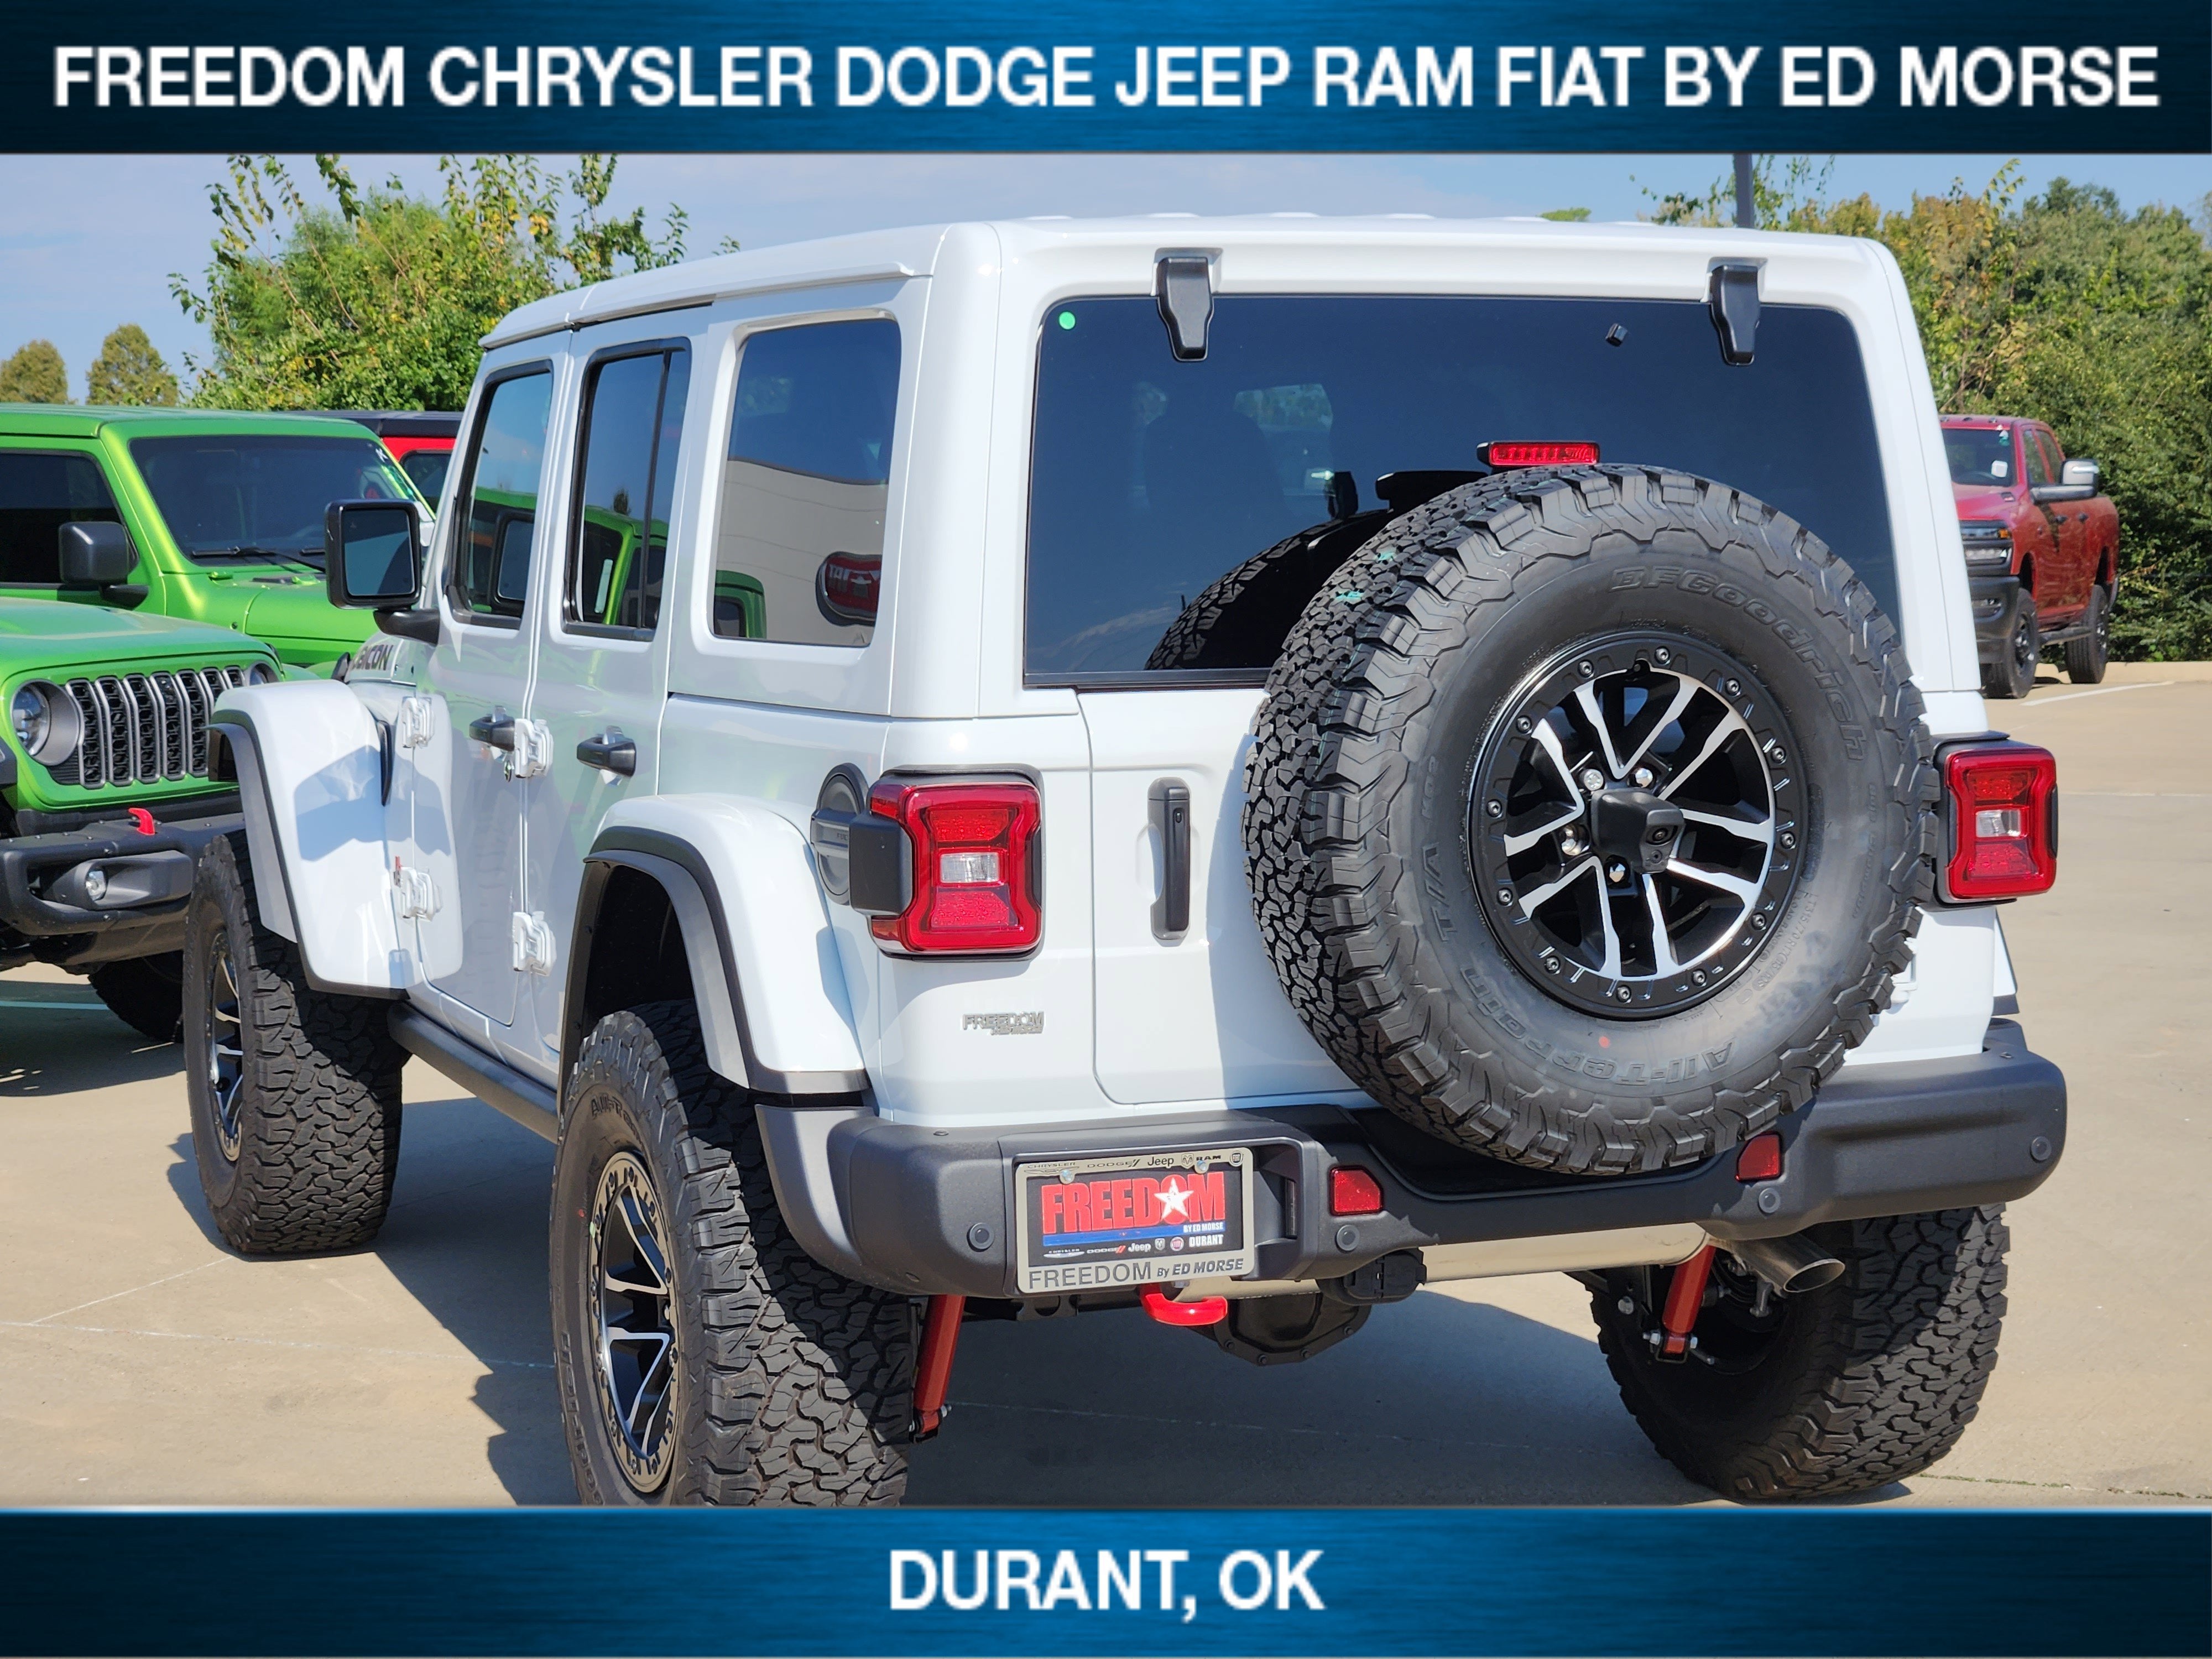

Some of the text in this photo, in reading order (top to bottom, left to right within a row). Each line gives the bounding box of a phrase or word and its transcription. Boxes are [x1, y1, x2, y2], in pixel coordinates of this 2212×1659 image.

[1608, 565, 1867, 761] BFGoodrich
[1422, 842, 1457, 941] T/A
[962, 1011, 1045, 1031] FREEDOM
[1460, 967, 1736, 1087] All-Terrain
[1147, 1156, 1174, 1167] Jeep
[1041, 1171, 1225, 1234] FREEDOM
[1128, 1243, 1151, 1253] Jeep
[1189, 1234, 1224, 1248] DURANT
[1183, 1222, 1224, 1233] BY ED MORSE
[1029, 1261, 1151, 1290] FREEDOM
[1172, 1263, 1191, 1276] ED
[1193, 1258, 1244, 1274] MORSE
